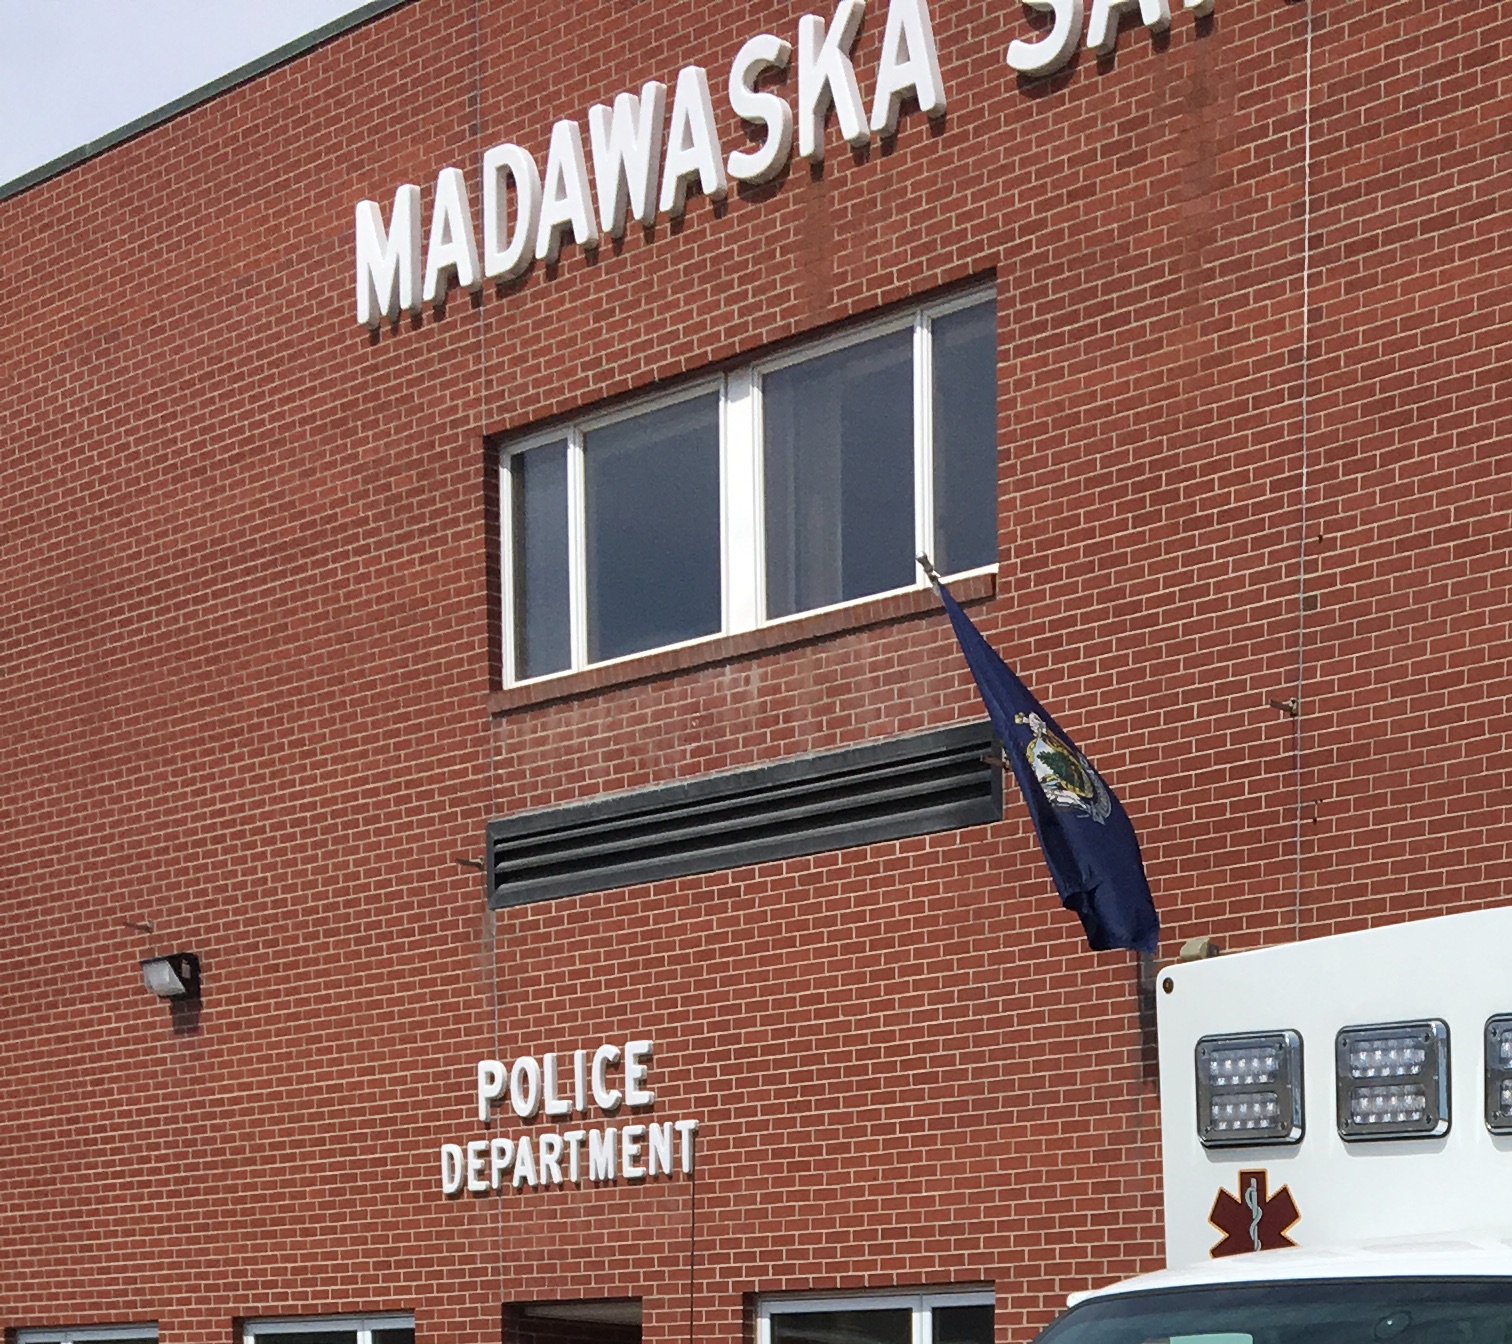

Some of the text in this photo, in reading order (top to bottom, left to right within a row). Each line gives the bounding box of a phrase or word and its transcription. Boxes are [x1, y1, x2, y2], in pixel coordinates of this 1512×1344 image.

[355, 0, 947, 329] MADAWASKA
[477, 1040, 654, 1122] POLICE
[440, 1119, 699, 1194] DEPARTMENT
